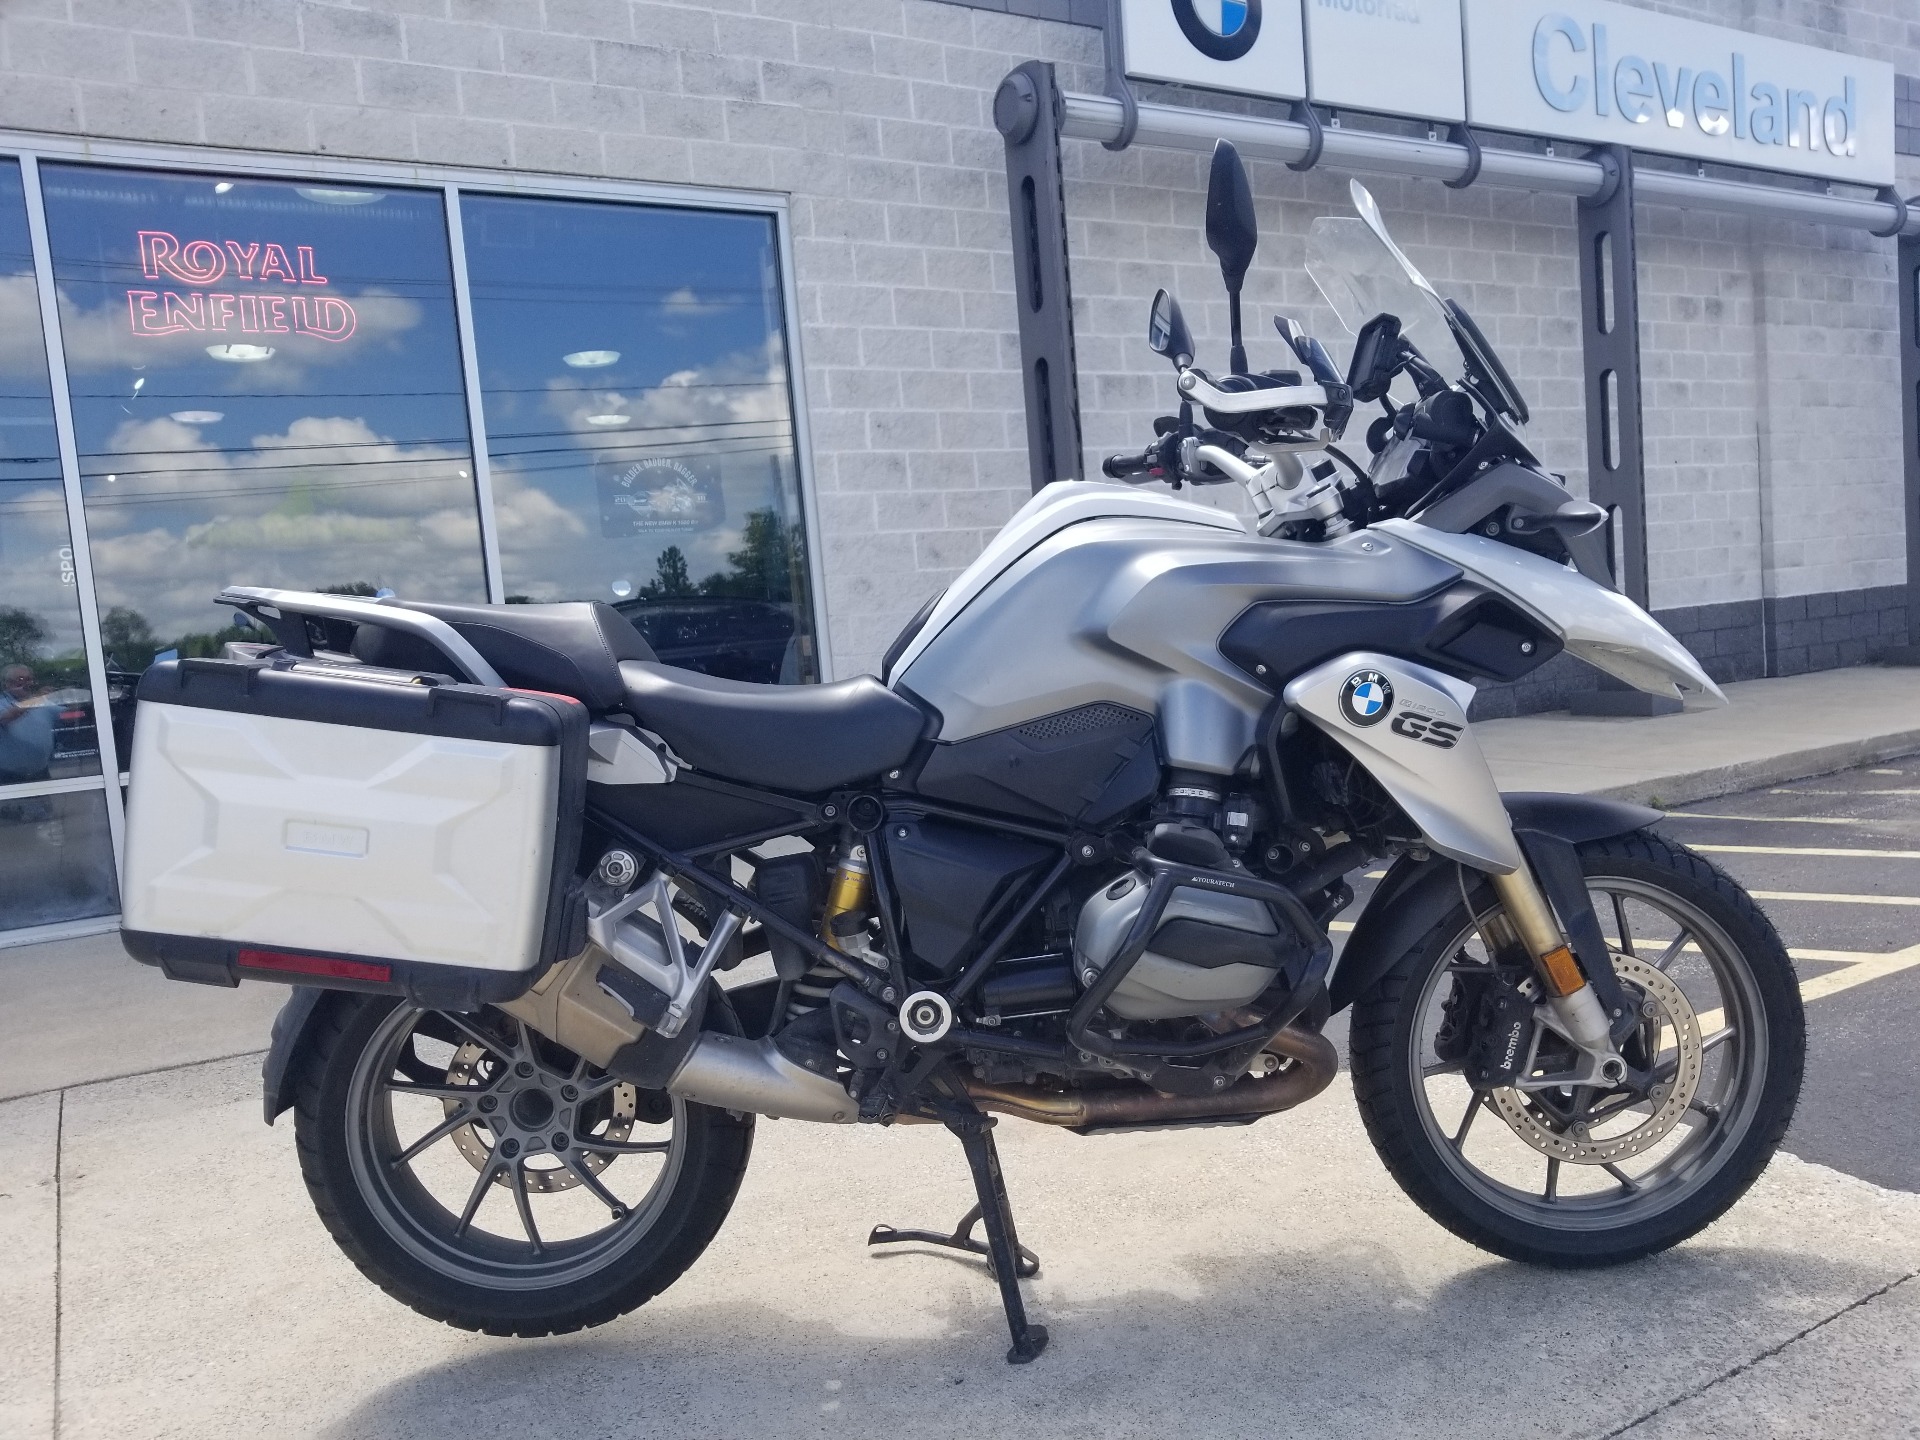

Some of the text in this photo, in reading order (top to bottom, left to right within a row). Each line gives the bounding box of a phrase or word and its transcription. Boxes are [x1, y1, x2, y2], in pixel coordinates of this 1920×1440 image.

[1532, 14, 1857, 157] Cleveland
[137, 230, 328, 285] ROYAL
[127, 290, 357, 343] ENFIELD
[1350, 672, 1392, 695] BMW
[1390, 710, 1465, 749] GS
[1500, 1021, 1522, 1070] brembo
